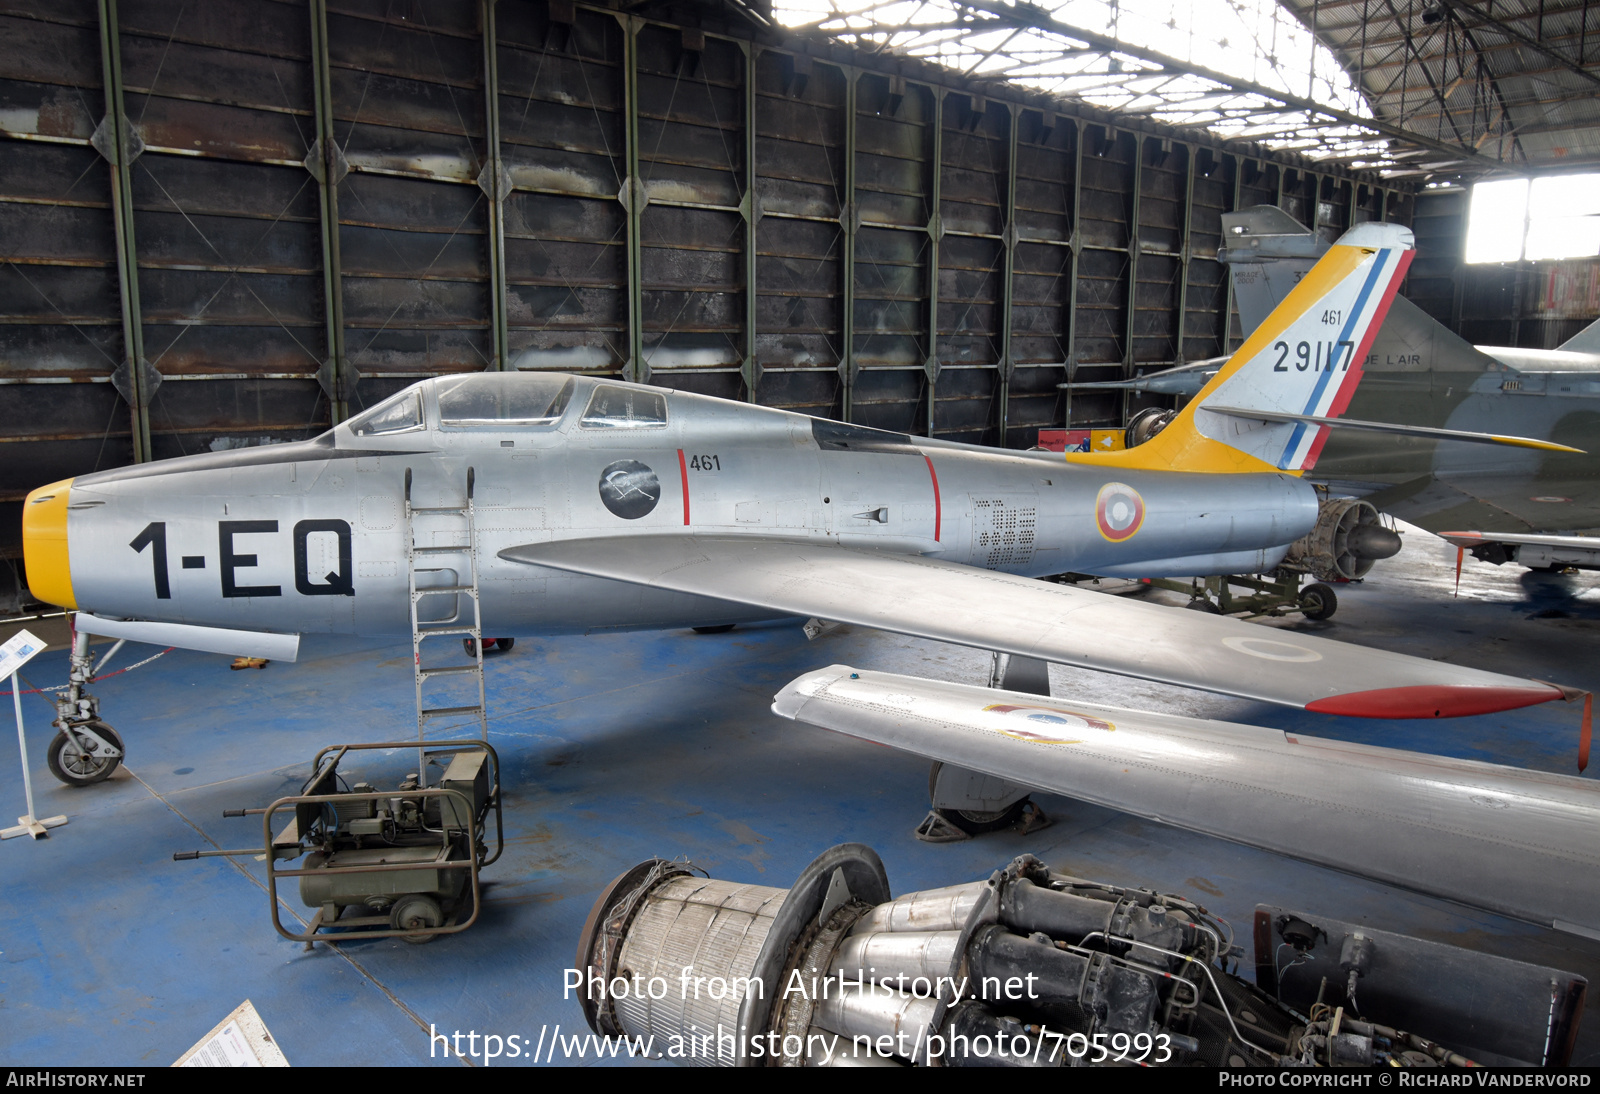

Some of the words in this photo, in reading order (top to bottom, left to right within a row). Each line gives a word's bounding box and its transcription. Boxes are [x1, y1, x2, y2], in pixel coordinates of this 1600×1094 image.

[1321, 310, 1341, 325] 461
[1273, 340, 1355, 372] 29117
[1386, 354, 1421, 365] L'AIR
[690, 455, 721, 471] 461
[129, 518, 356, 600] 1-EQ
